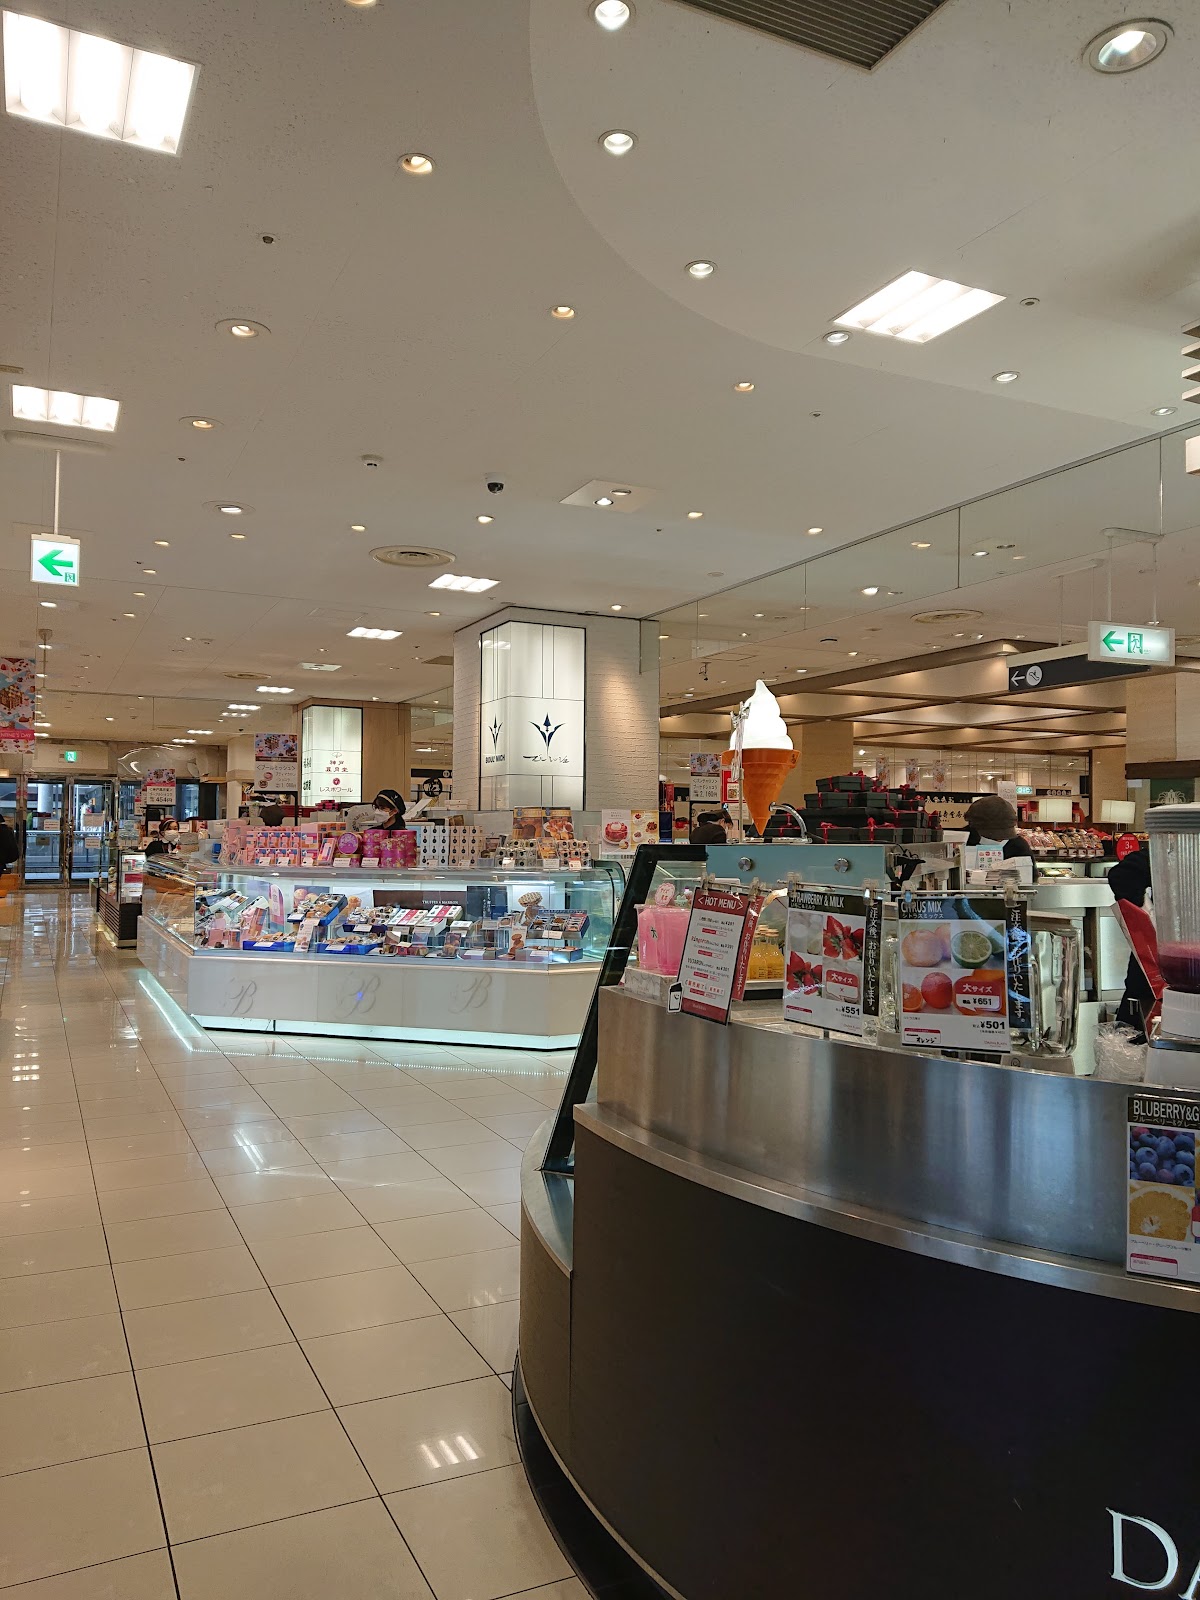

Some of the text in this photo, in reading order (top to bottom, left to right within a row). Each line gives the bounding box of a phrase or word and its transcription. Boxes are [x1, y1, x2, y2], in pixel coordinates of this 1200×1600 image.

[705, 896, 737, 910] HOT MENU
[790, 892, 845, 908] STRAWBERRY & MILK
[901, 900, 943, 913] CITRUS MIX
[831, 973, 853, 984] 大サイズ
[962, 983, 993, 993] 大サイズ
[972, 998, 992, 1006] ¥651
[841, 1006, 860, 1016] ¥551
[980, 1020, 1005, 1030] ¥501
[1133, 1115, 1200, 1129] ブルーベリー&グレー
[1105, 1506, 1200, 1600] D
